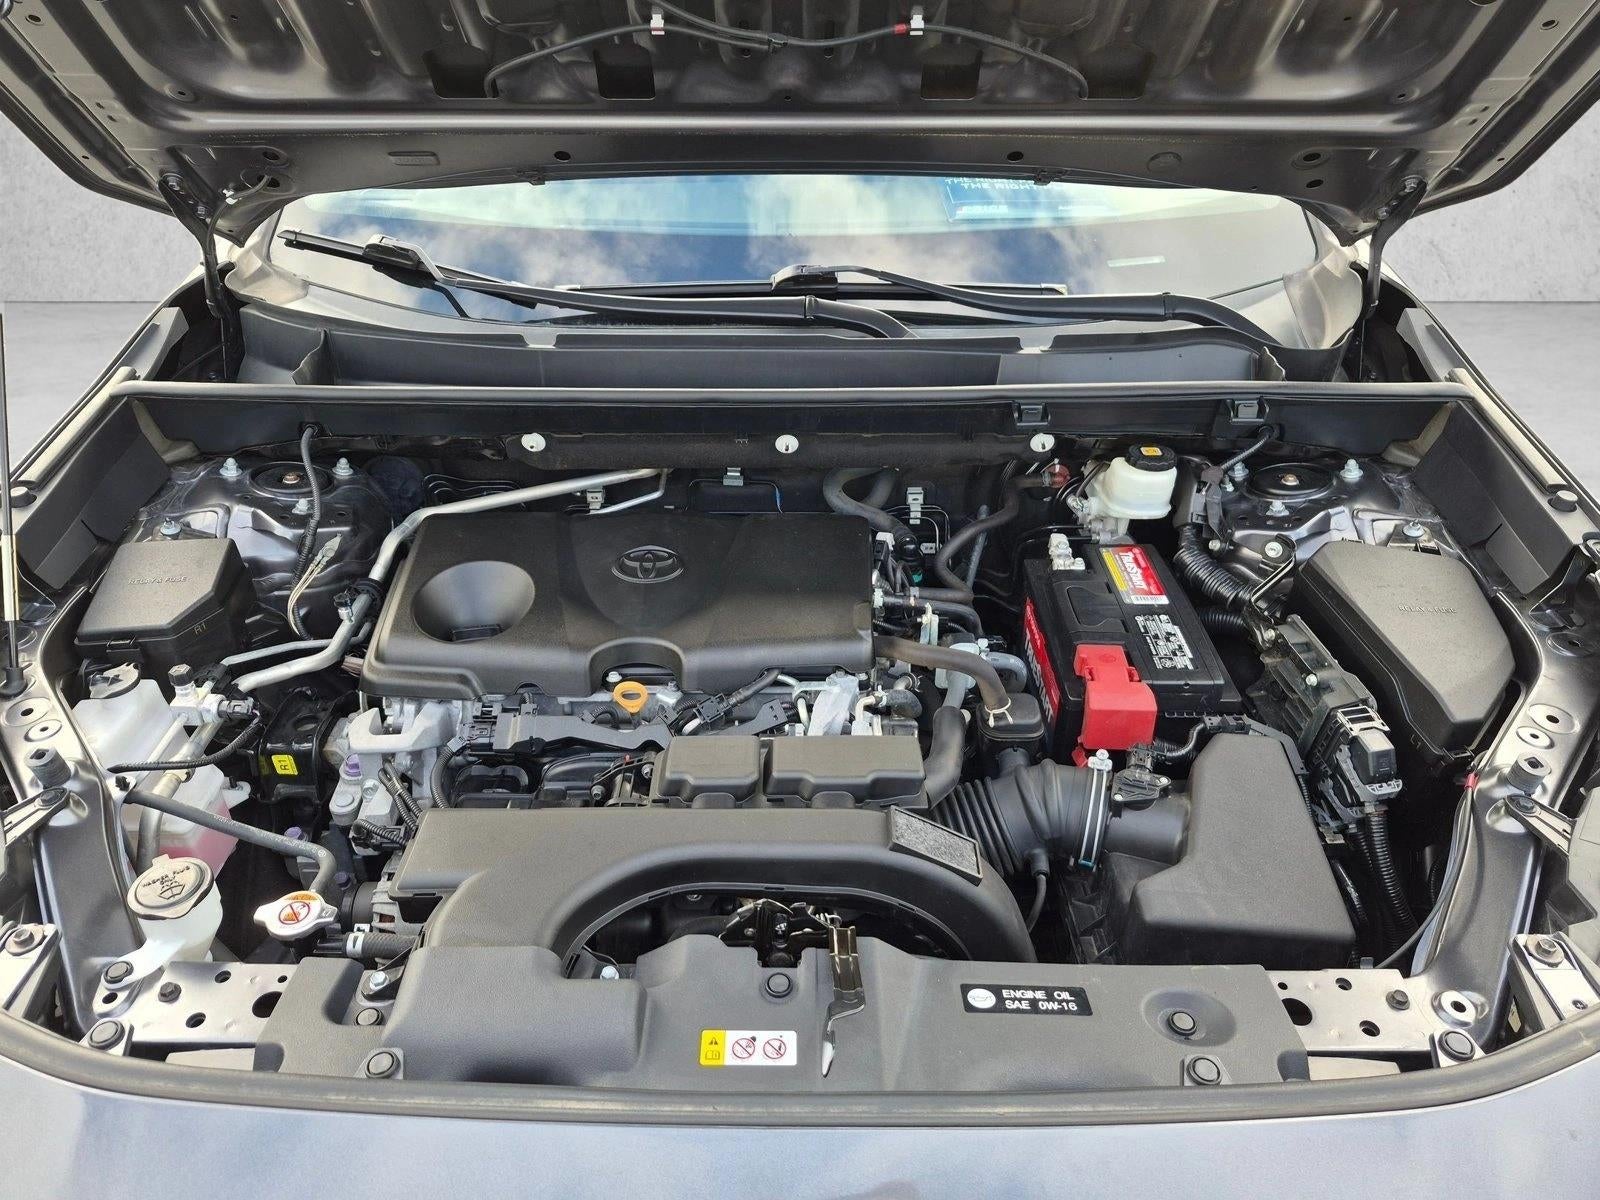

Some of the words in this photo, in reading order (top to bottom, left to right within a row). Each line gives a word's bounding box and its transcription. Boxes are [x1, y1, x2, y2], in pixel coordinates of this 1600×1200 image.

[194, 621, 206, 635] R1
[278, 759, 290, 771] R1
[1001, 989, 1047, 1000] ENGINE
[1053, 990, 1075, 1001] OIL
[1005, 1000, 1031, 1010] SAE
[1038, 1001, 1077, 1011] 0W-16
